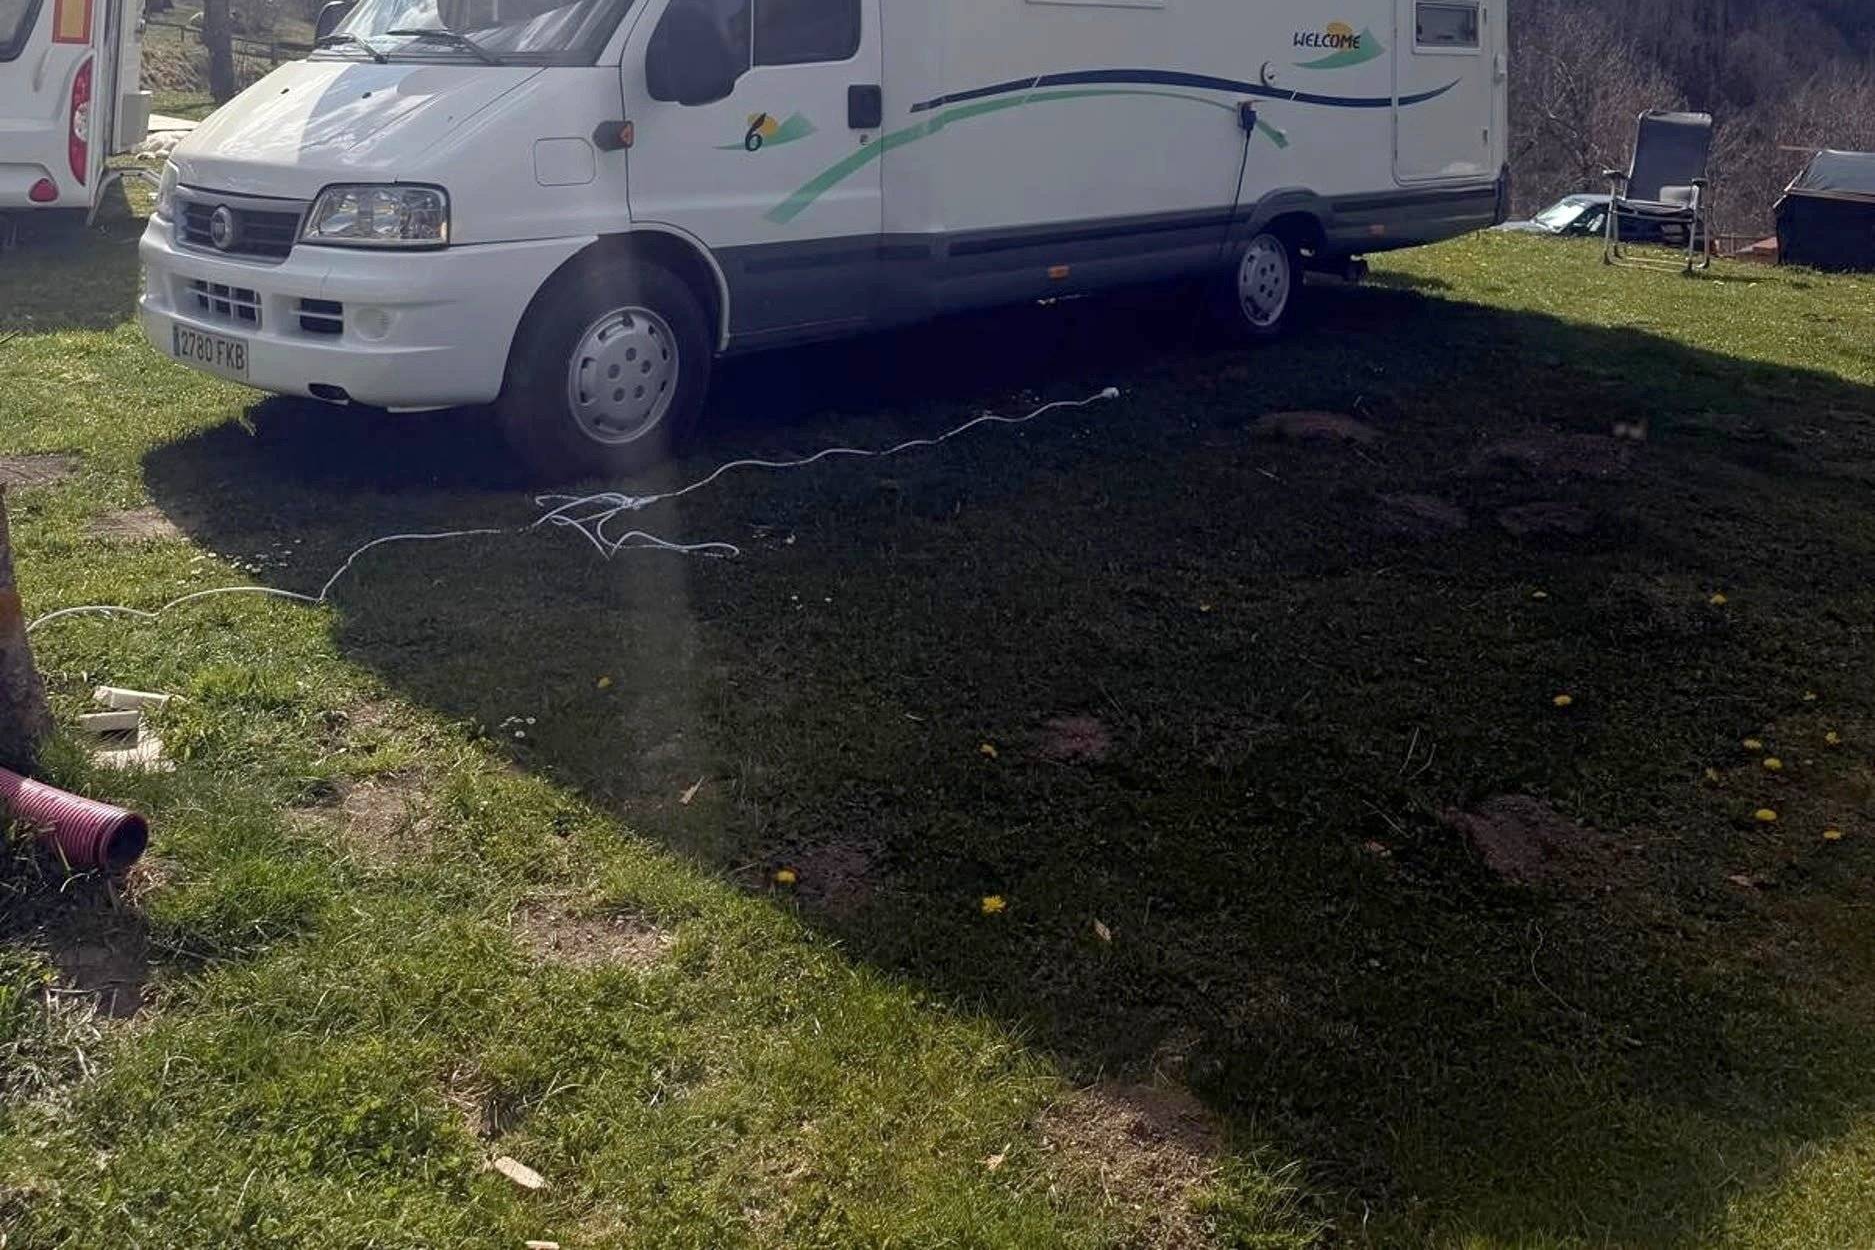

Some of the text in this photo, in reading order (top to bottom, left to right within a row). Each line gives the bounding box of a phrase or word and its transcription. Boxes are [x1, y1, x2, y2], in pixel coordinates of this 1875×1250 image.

[1292, 32, 1362, 49] WELCOME
[745, 112, 767, 152] 6
[181, 331, 245, 370] 2780 FKB
